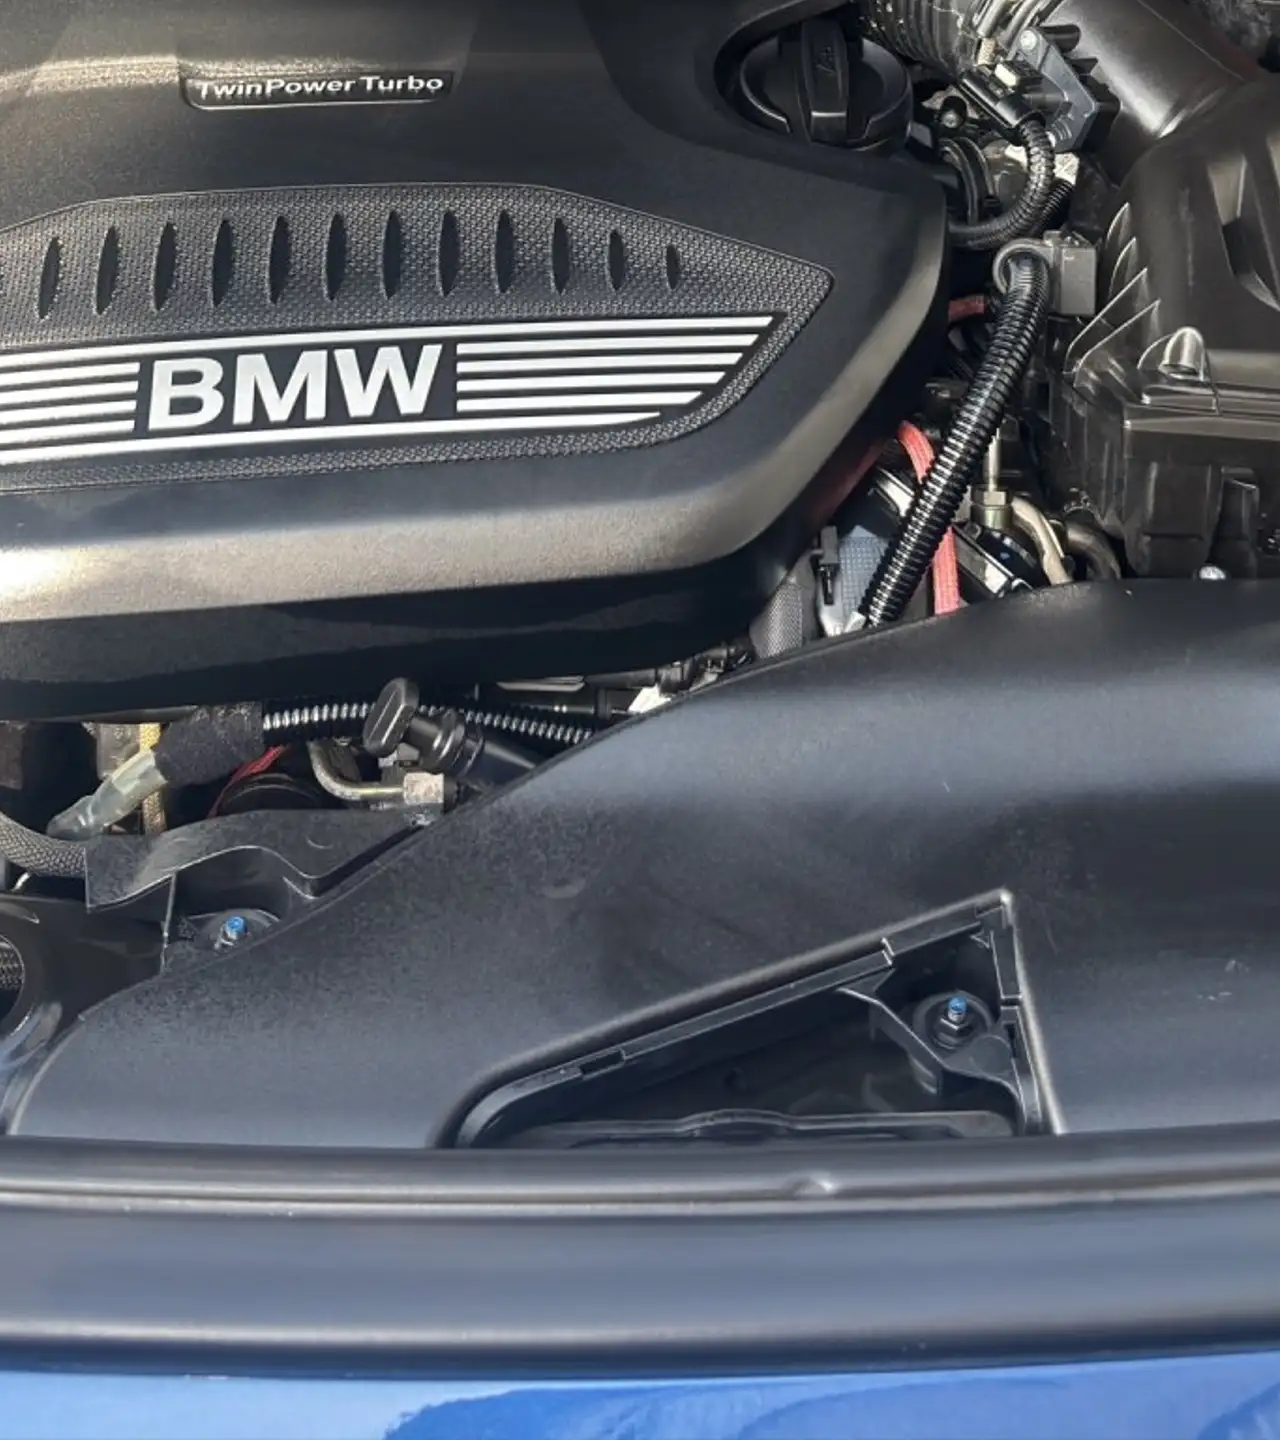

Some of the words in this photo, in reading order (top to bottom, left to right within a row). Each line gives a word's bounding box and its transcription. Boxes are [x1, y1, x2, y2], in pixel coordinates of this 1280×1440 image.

[199, 76, 356, 100] TwinPower
[360, 74, 444, 92] Turbo
[148, 343, 443, 431] BMW
